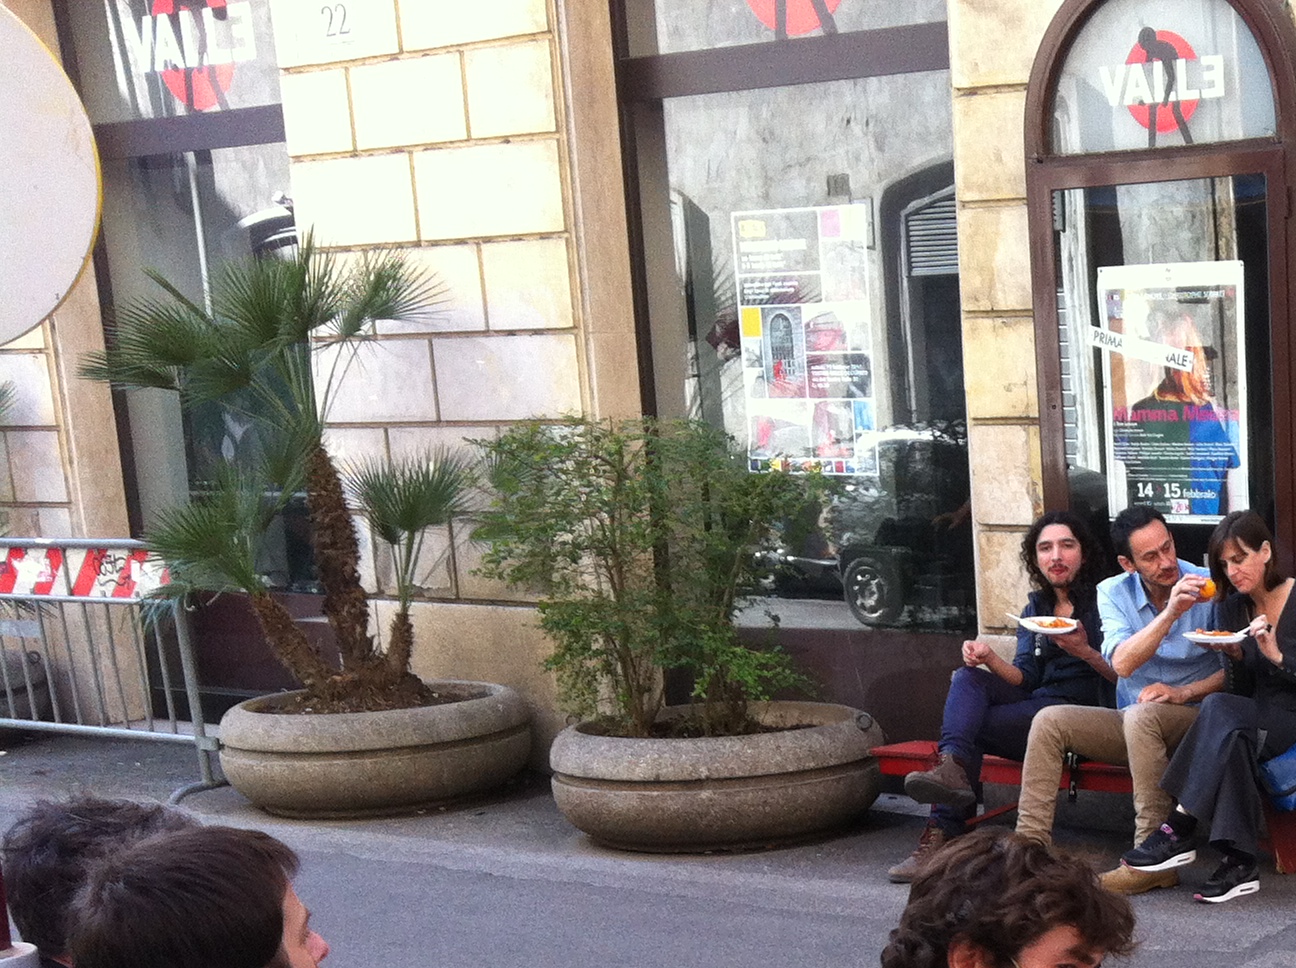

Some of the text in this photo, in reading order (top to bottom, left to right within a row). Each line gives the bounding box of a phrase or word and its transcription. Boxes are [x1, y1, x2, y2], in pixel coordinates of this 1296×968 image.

[122, 2, 257, 73] VALLE
[321, 4, 350, 37] 22
[1099, 54, 1225, 106] VALLE
[1137, 482, 1217, 499] 14 15 febbraio
